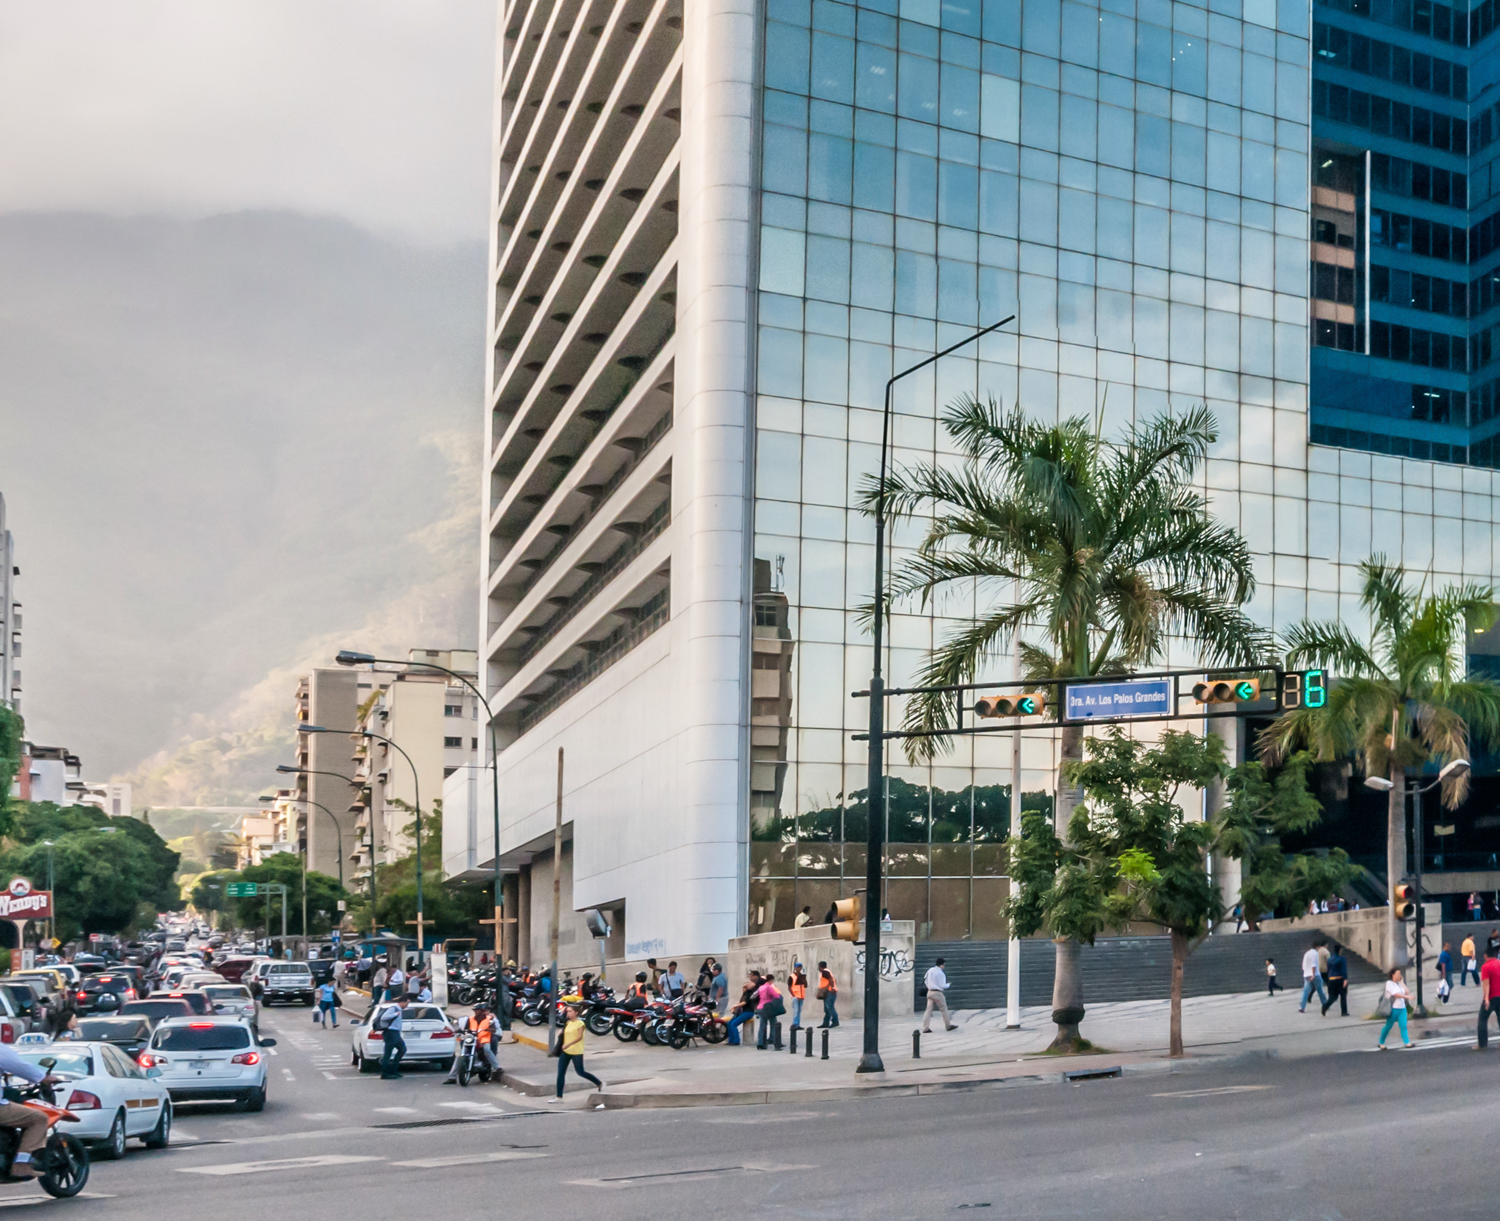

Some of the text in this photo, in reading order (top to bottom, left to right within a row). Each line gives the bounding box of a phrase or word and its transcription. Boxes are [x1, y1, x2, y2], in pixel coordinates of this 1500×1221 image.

[1070, 691, 1166, 707] 3ra. Av. Los Palos Grandes
[1305, 670, 1325, 708] 6
